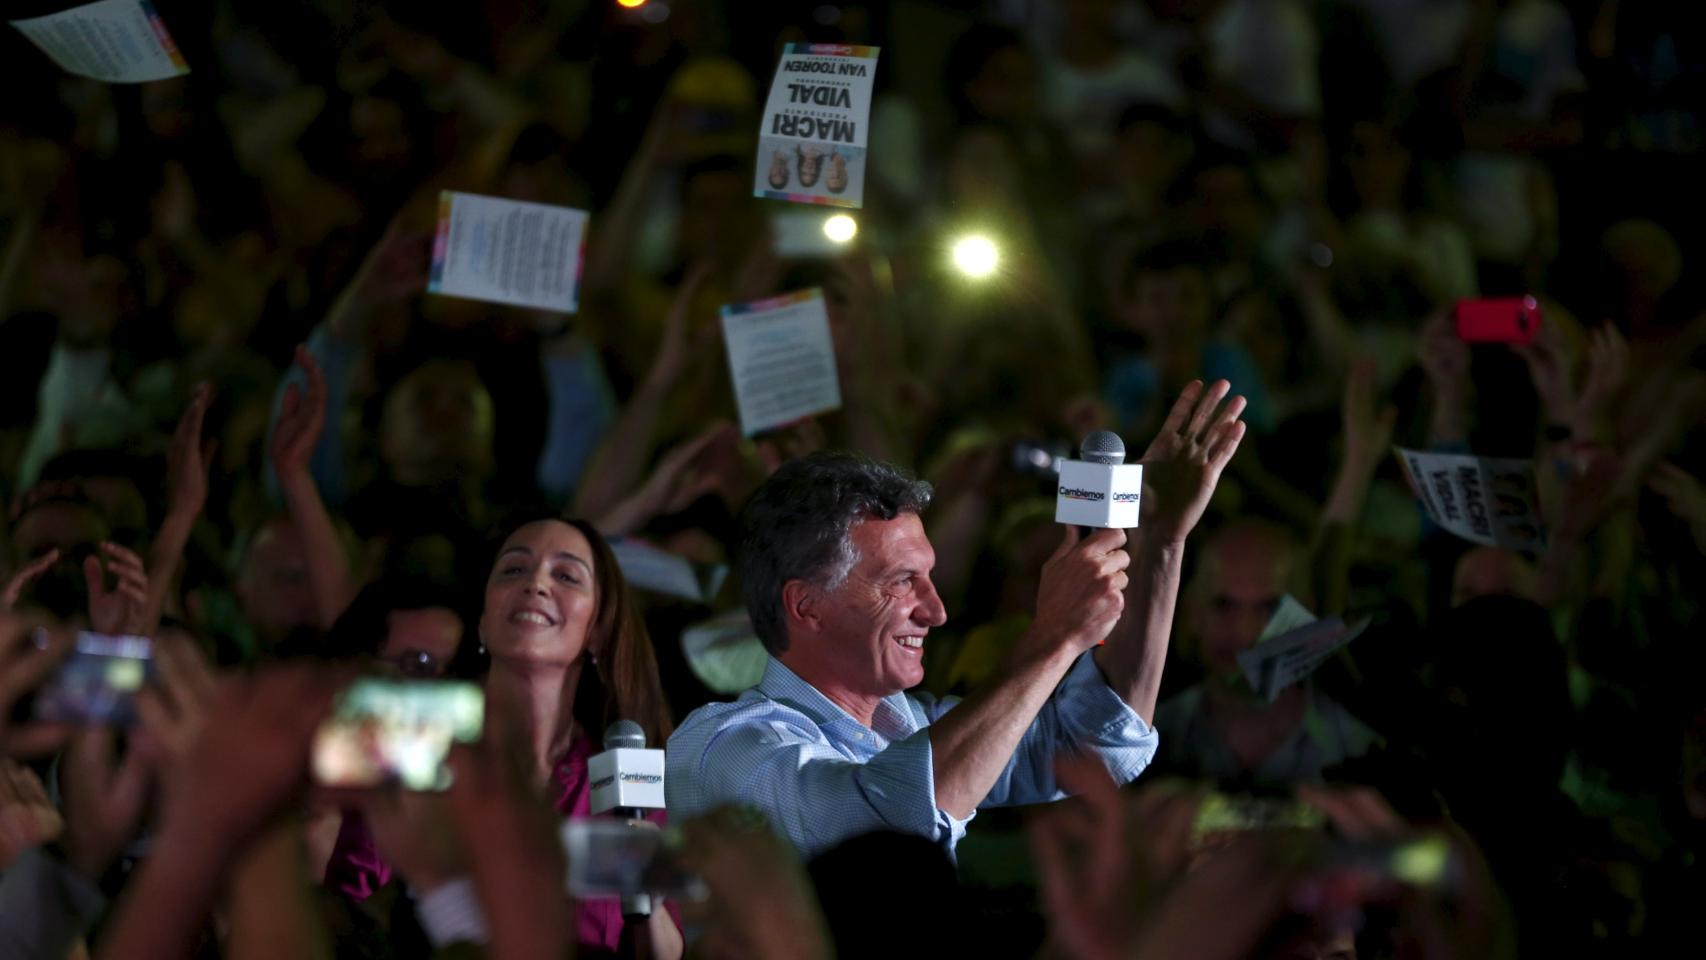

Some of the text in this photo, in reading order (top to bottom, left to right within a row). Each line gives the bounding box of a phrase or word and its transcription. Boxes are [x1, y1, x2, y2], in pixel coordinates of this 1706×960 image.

[784, 61, 867, 77] VAN TOOREN
[787, 84, 851, 108] VIDAL
[785, 108, 847, 119] PRESIDENTE
[771, 113, 856, 143] MACRI
[1059, 486, 1105, 500] Cambiemos
[1457, 466, 1492, 537] MACRI
[620, 772, 662, 782] Cambiemos
